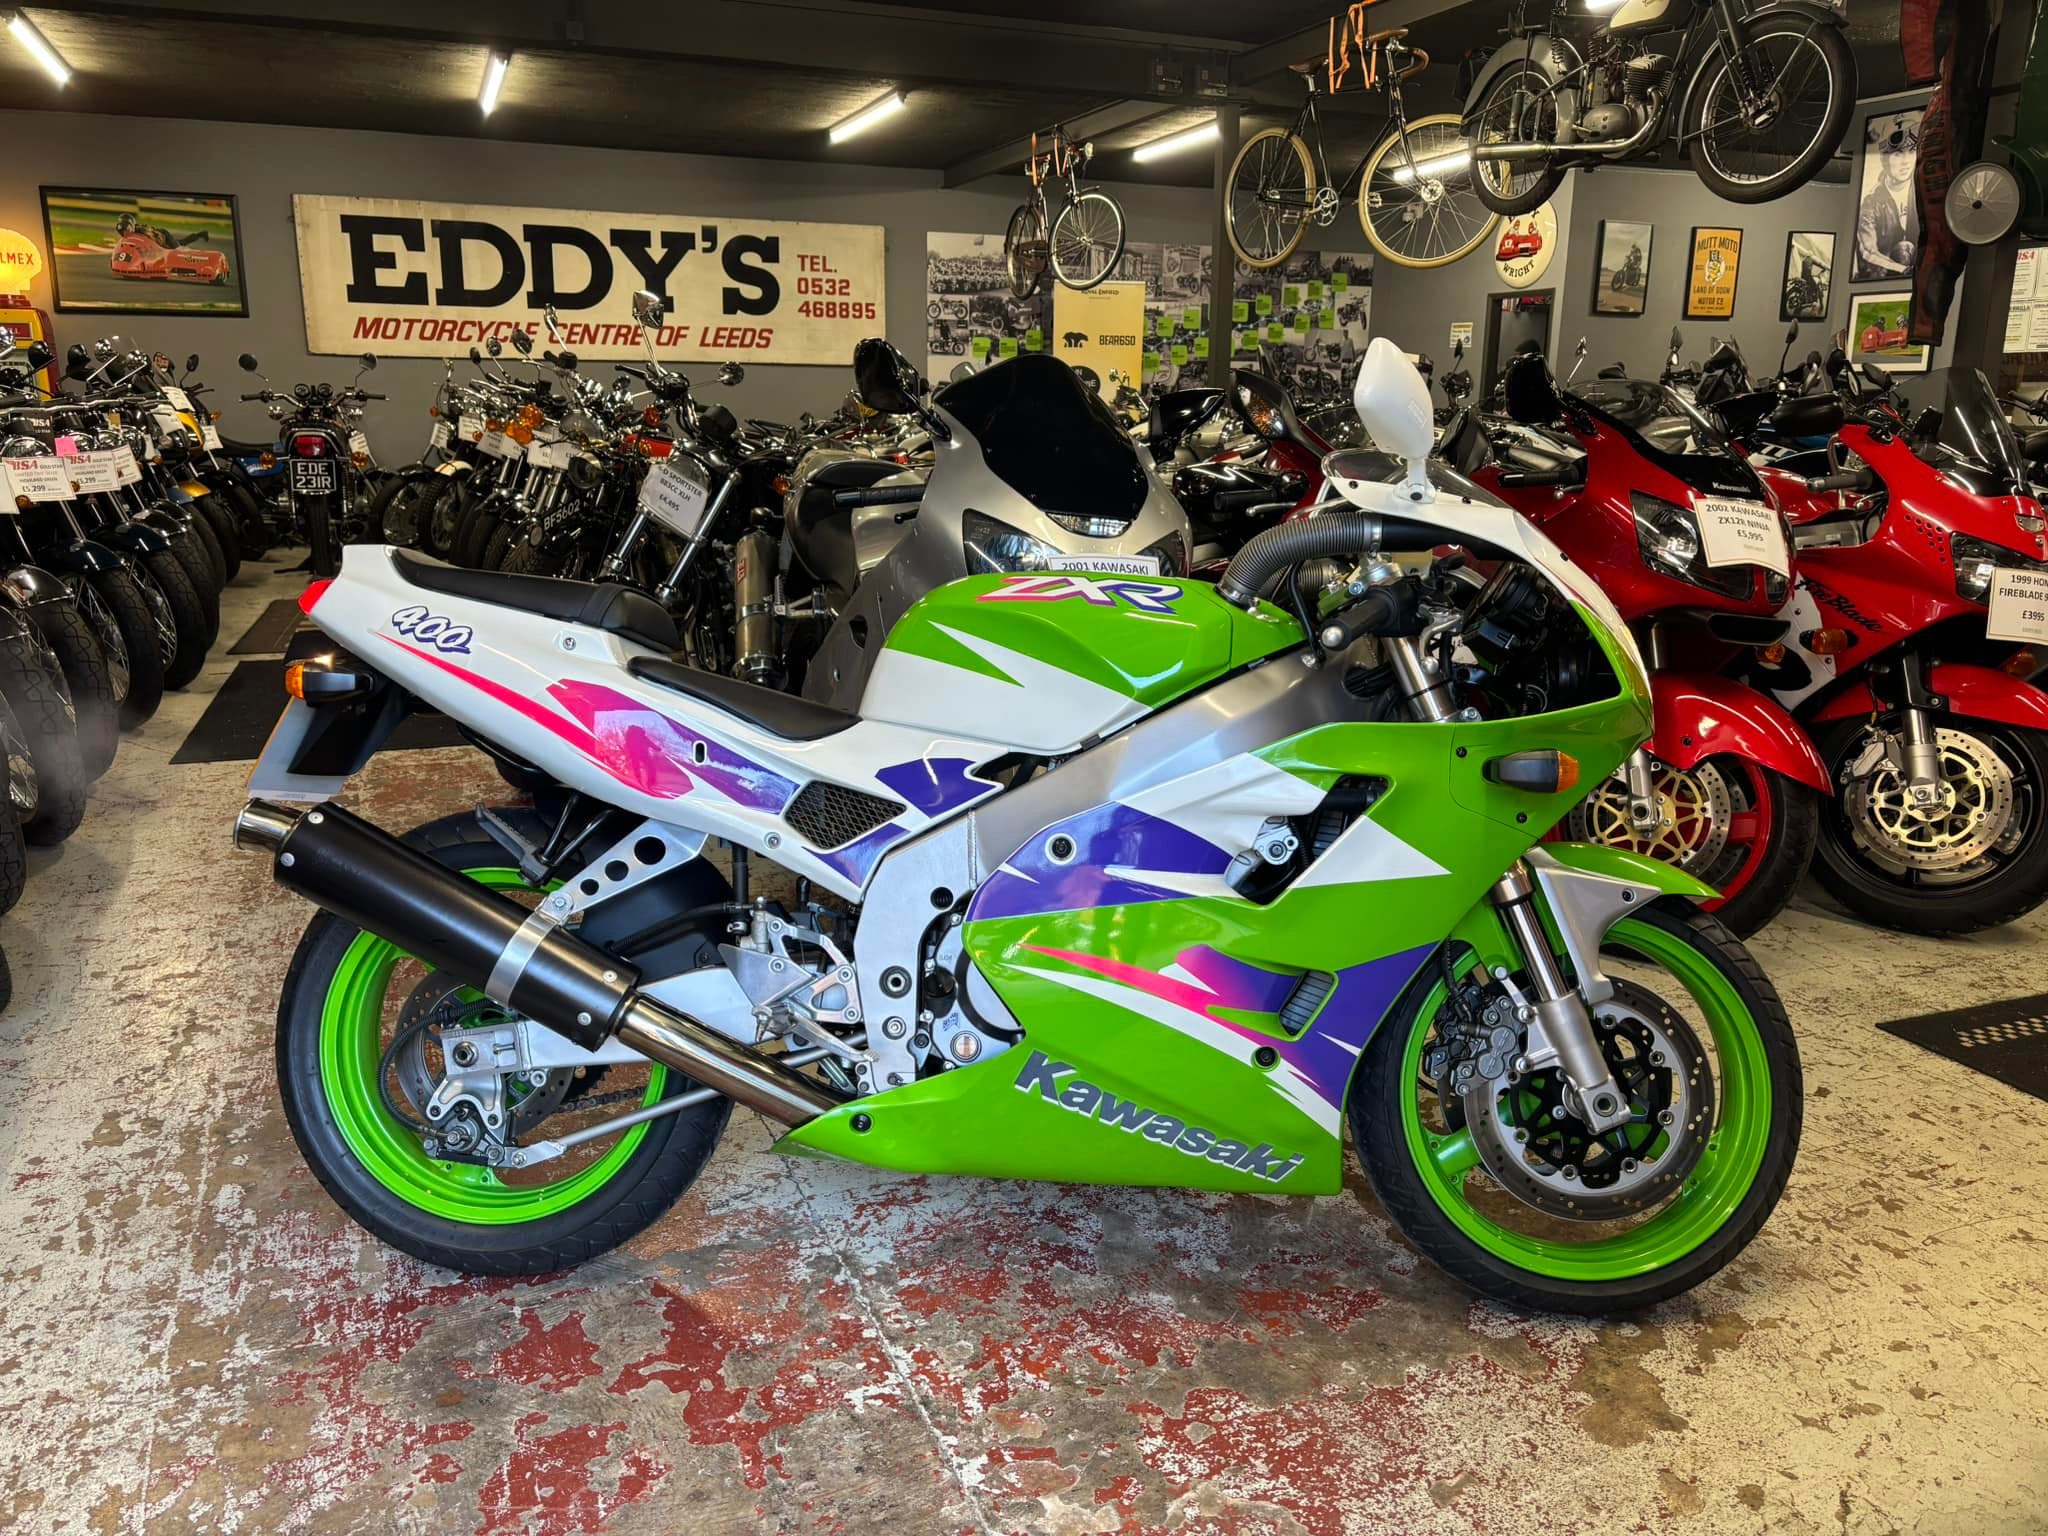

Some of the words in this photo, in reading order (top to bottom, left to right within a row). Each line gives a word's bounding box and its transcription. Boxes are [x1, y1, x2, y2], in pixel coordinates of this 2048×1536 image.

[340, 213, 781, 316] EDDY'S
[797, 254, 838, 273] TEL.
[1503, 259, 1535, 278] WRIGHT
[797, 277, 850, 296] 0532
[797, 300, 876, 320] 468895
[548, 322, 643, 346] CENTRE
[655, 326, 690, 347] OF
[699, 326, 773, 349] LEEDS
[297, 462, 328, 476] EDE
[543, 498, 581, 531] BF5602
[1092, 562, 1149, 575] KAWASAKI
[2011, 574, 2032, 585] 1999
[976, 575, 1184, 615] ZXR
[2000, 587, 2043, 601] FIREBLADE
[392, 605, 474, 655] 400
[1014, 1048, 1306, 1184] Kawasaki
